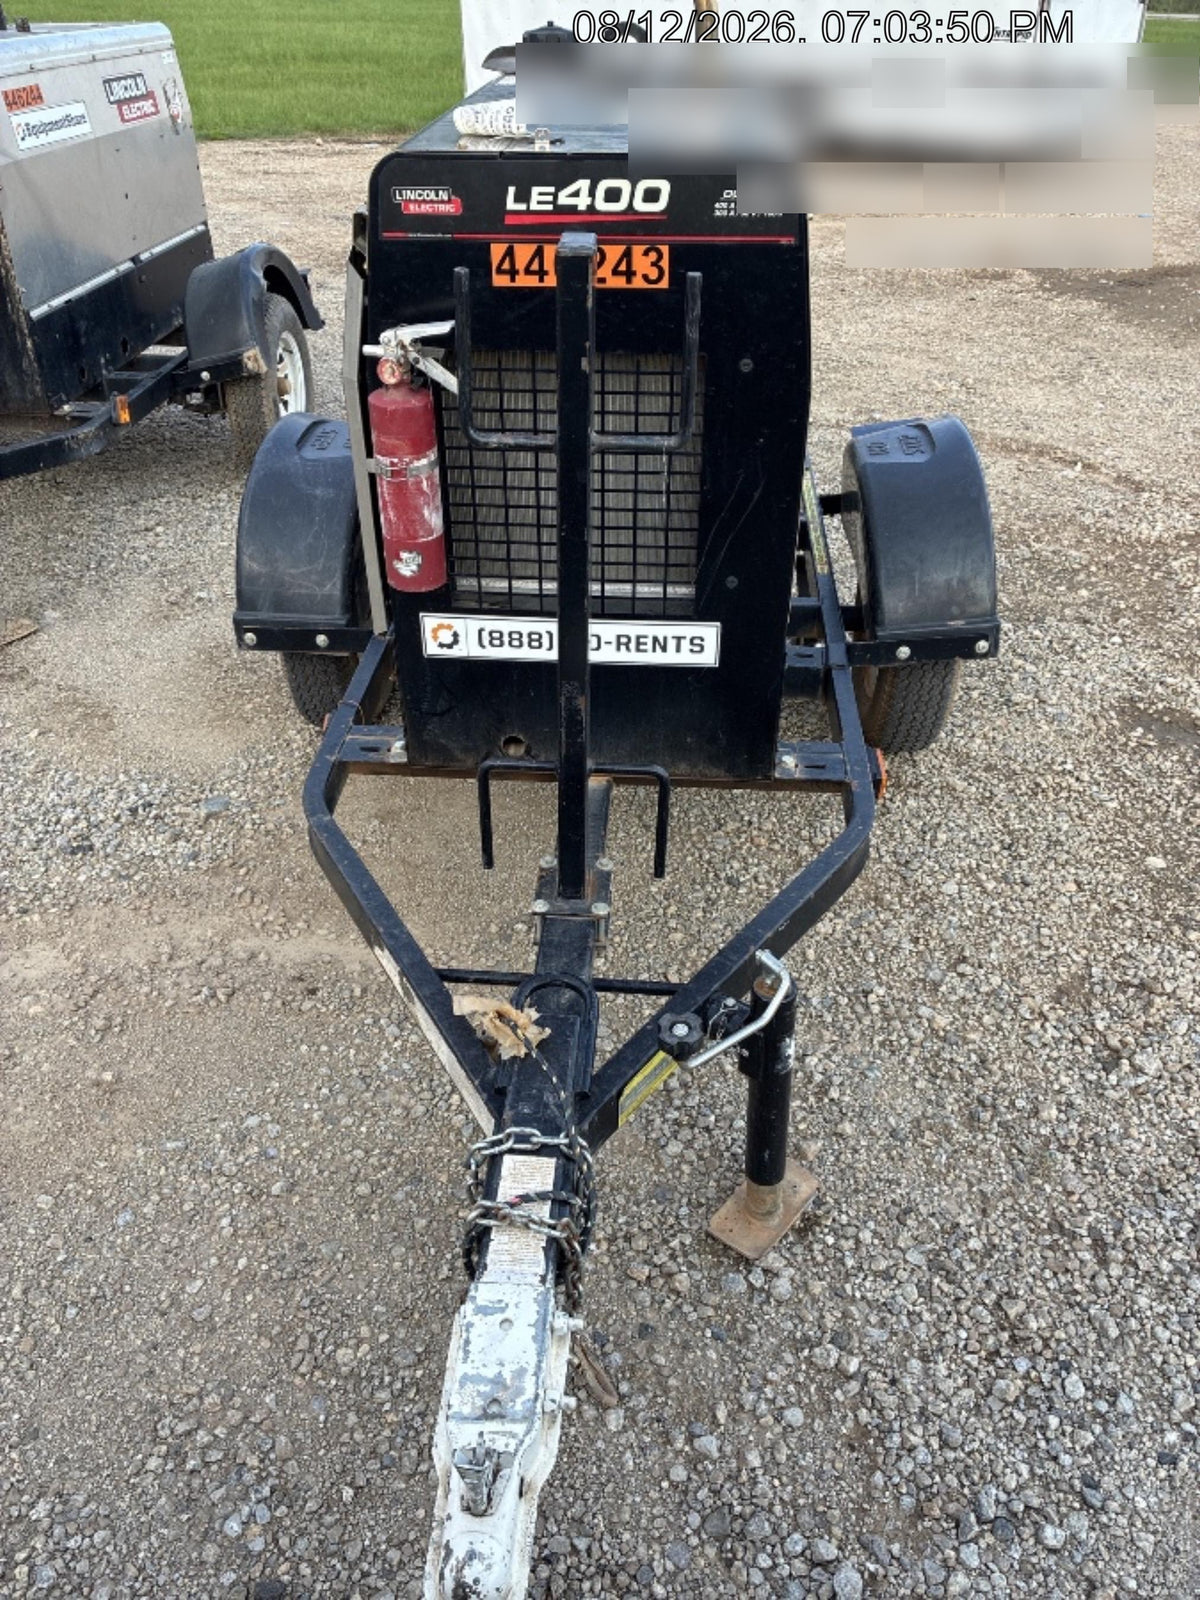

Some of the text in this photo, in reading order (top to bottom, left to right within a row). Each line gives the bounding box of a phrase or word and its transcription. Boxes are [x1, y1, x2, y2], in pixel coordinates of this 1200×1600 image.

[105, 76, 148, 101] LINCOLN
[122, 100, 156, 119] ELECTRIC
[395, 189, 449, 201] LINCOLN
[506, 179, 671, 212] LE400
[408, 203, 456, 213] ELECTRIC
[495, 244, 665, 285] 44243
[477, 627, 554, 650] (888)
